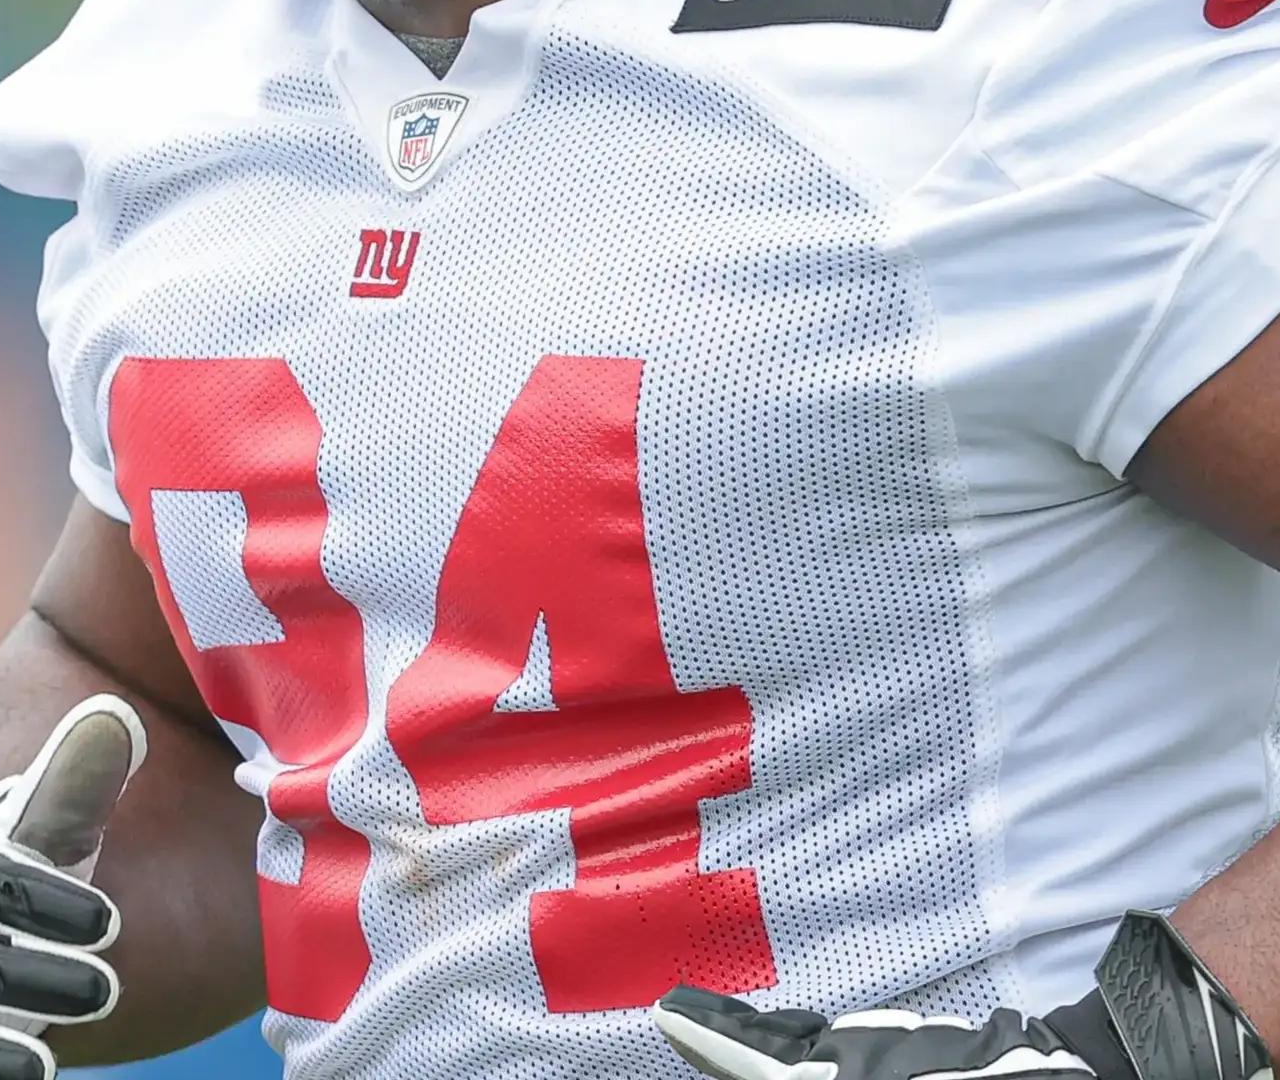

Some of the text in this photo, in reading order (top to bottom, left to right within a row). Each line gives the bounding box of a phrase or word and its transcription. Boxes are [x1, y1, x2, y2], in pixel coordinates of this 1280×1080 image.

[393, 98, 462, 120] EQUIPMENT
[402, 138, 429, 166] NFL
[108, 354, 778, 1023] 94
